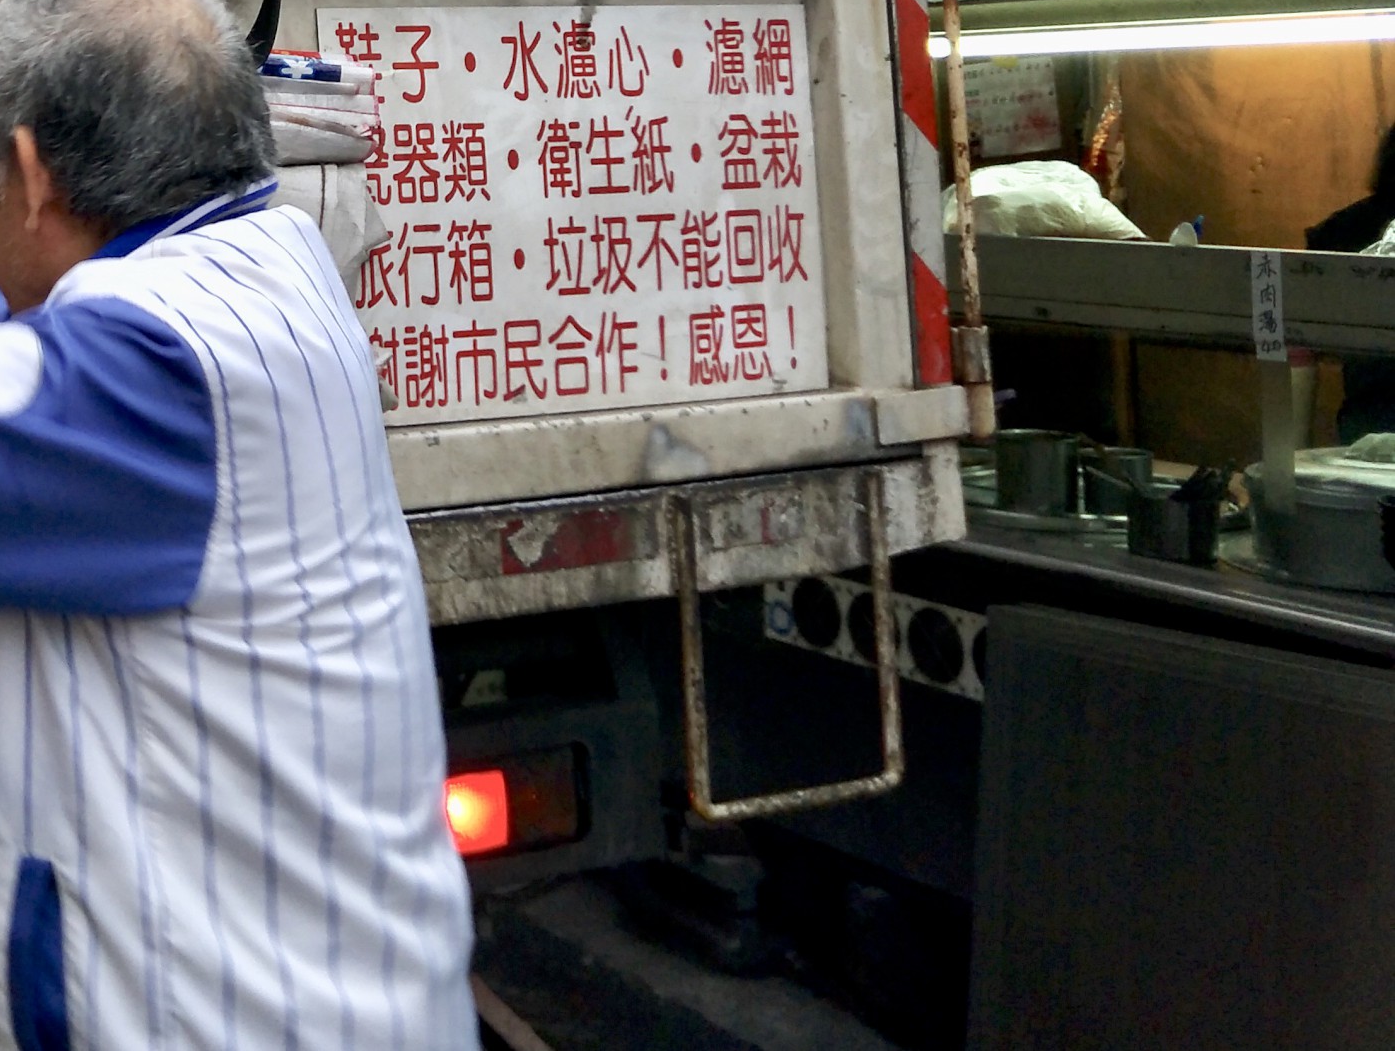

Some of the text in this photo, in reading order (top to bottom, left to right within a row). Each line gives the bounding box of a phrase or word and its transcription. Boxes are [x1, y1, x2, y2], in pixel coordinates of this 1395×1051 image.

[500, 19, 649, 101] 水濾心
[704, 19, 794, 96] 濾網
[537, 108, 674, 199] 衛生紙
[719, 113, 802, 190] 盆栽
[543, 209, 808, 297] 垃圾不能回收
